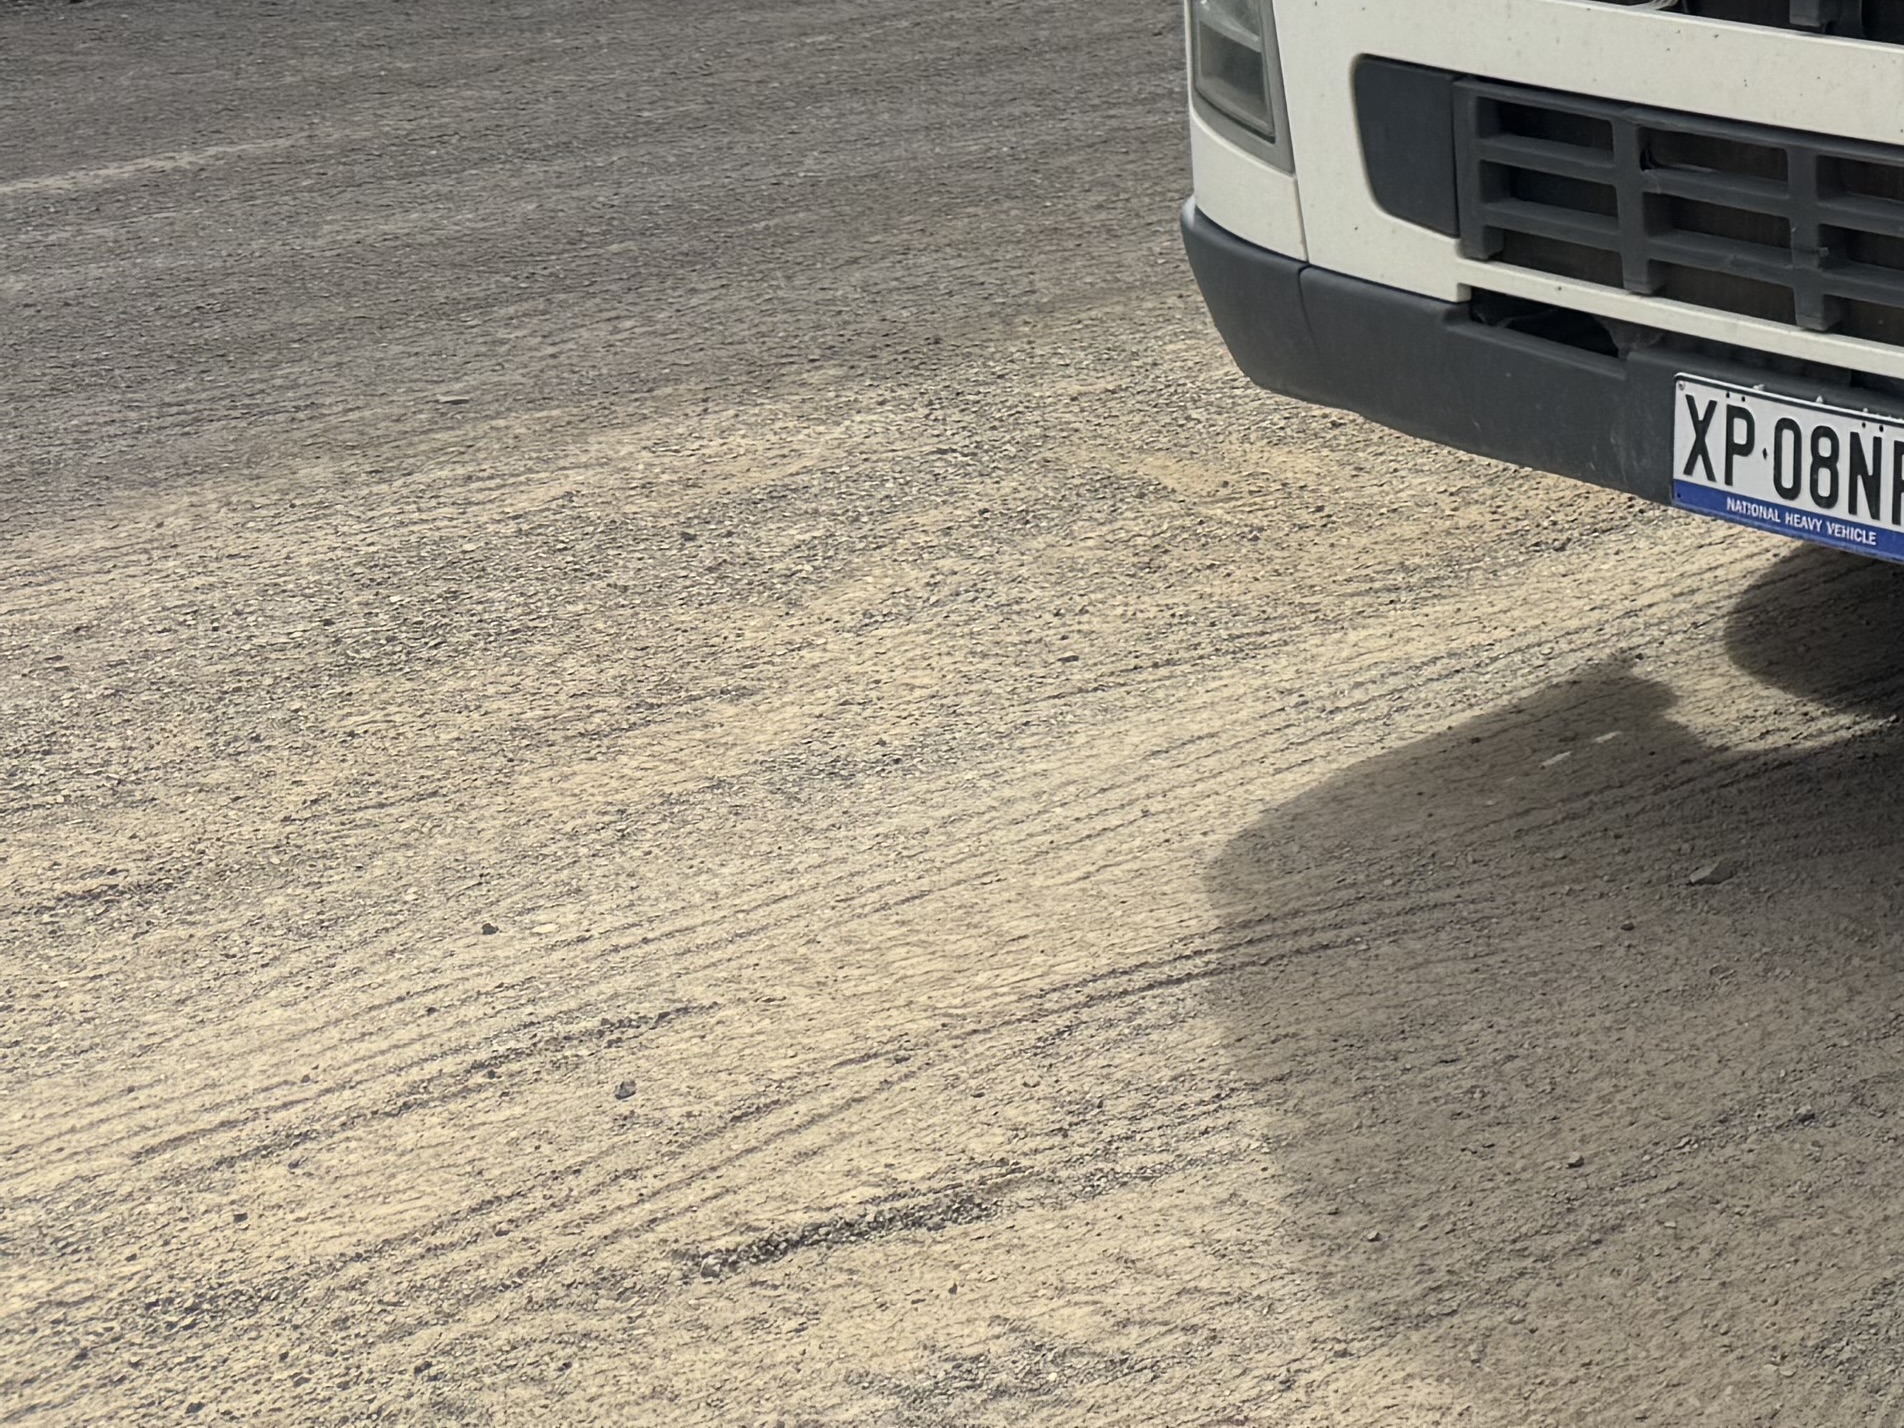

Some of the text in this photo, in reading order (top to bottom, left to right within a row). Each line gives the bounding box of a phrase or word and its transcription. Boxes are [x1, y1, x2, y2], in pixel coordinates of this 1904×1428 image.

[1726, 497, 1877, 546] NATIONAL HEAVY VEHICLE
